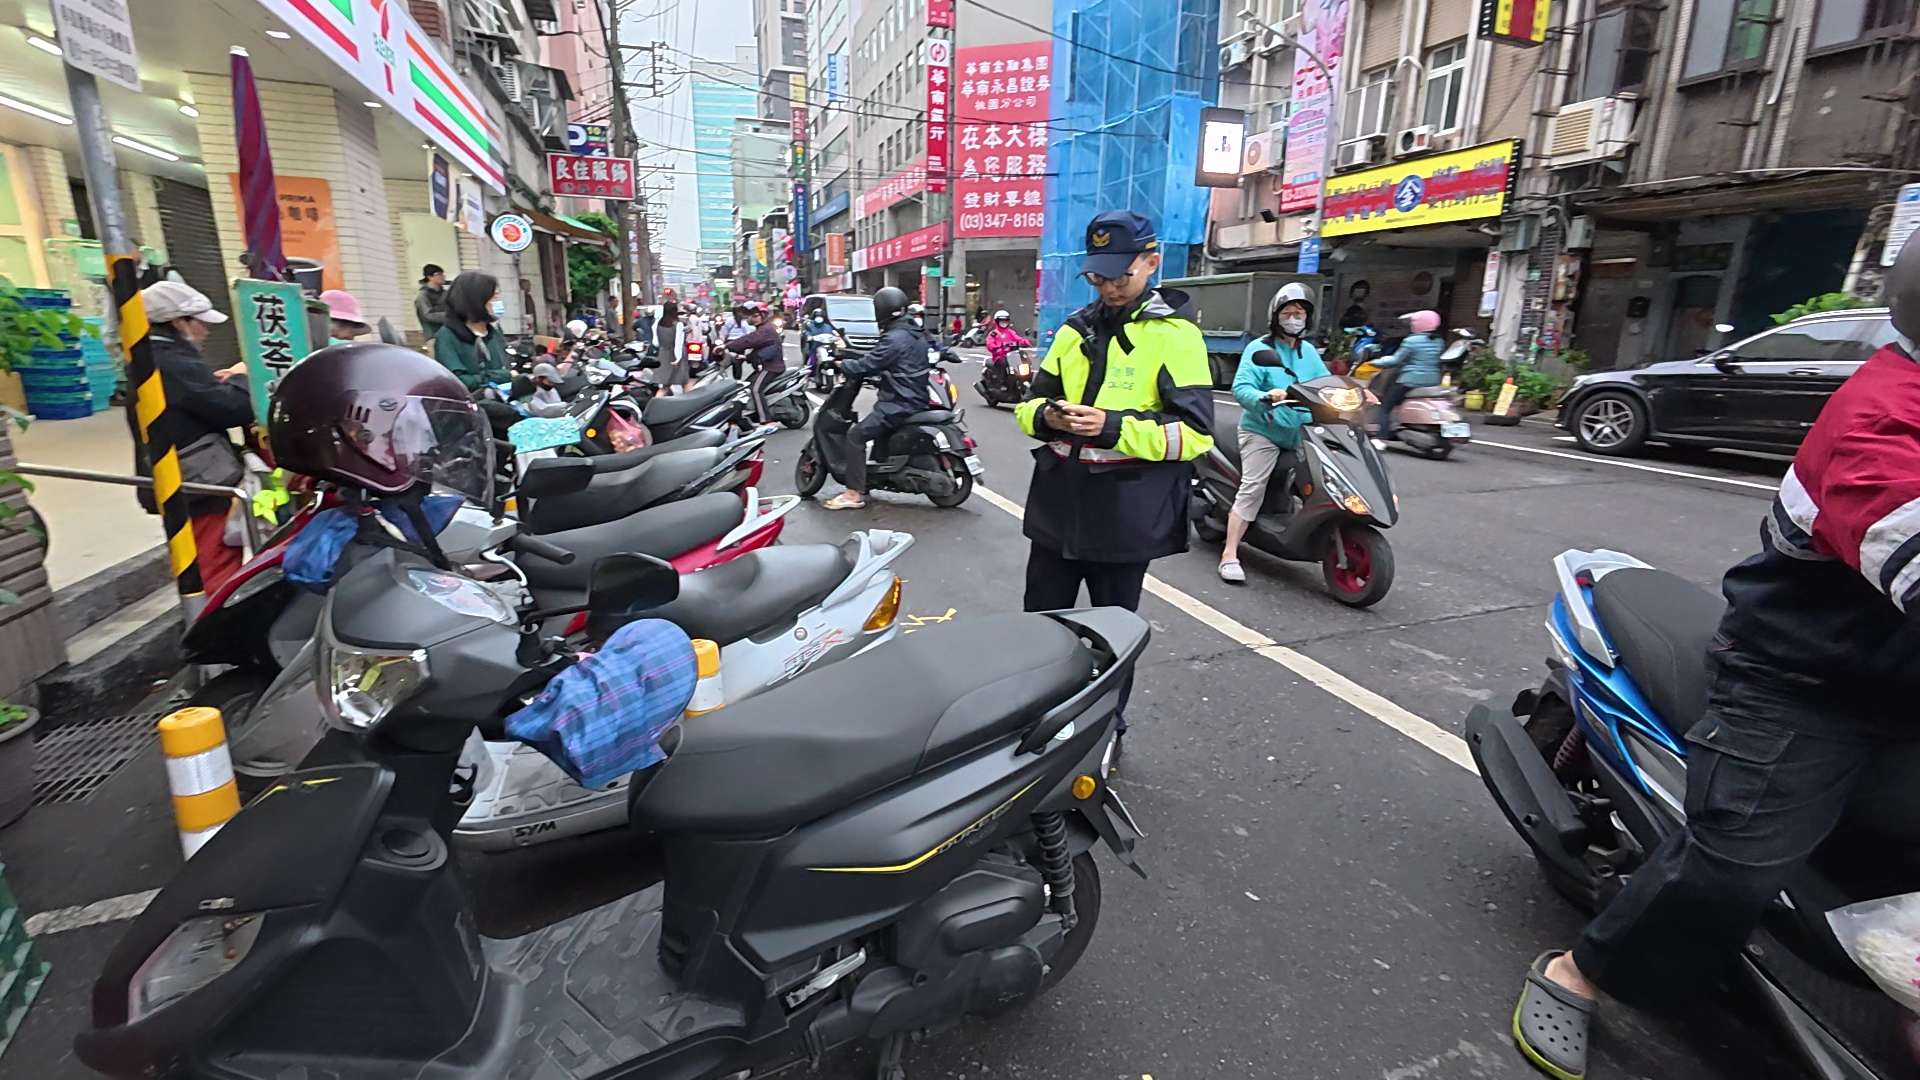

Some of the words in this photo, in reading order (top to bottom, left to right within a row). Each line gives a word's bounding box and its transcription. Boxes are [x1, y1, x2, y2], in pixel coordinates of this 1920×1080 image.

[965, 56, 1049, 75] 華南金融集團
[960, 75, 1051, 98] 華南永昌證券
[930, 69, 946, 141] 華南銀行
[974, 95, 1037, 110] 桃園分公司
[961, 122, 1049, 150] 在本大樓
[963, 190, 1042, 208] 發財專線
[960, 212, 1045, 231] (03)347-8168
[252, 293, 292, 400] 茯苓
[514, 820, 556, 838] SYM
